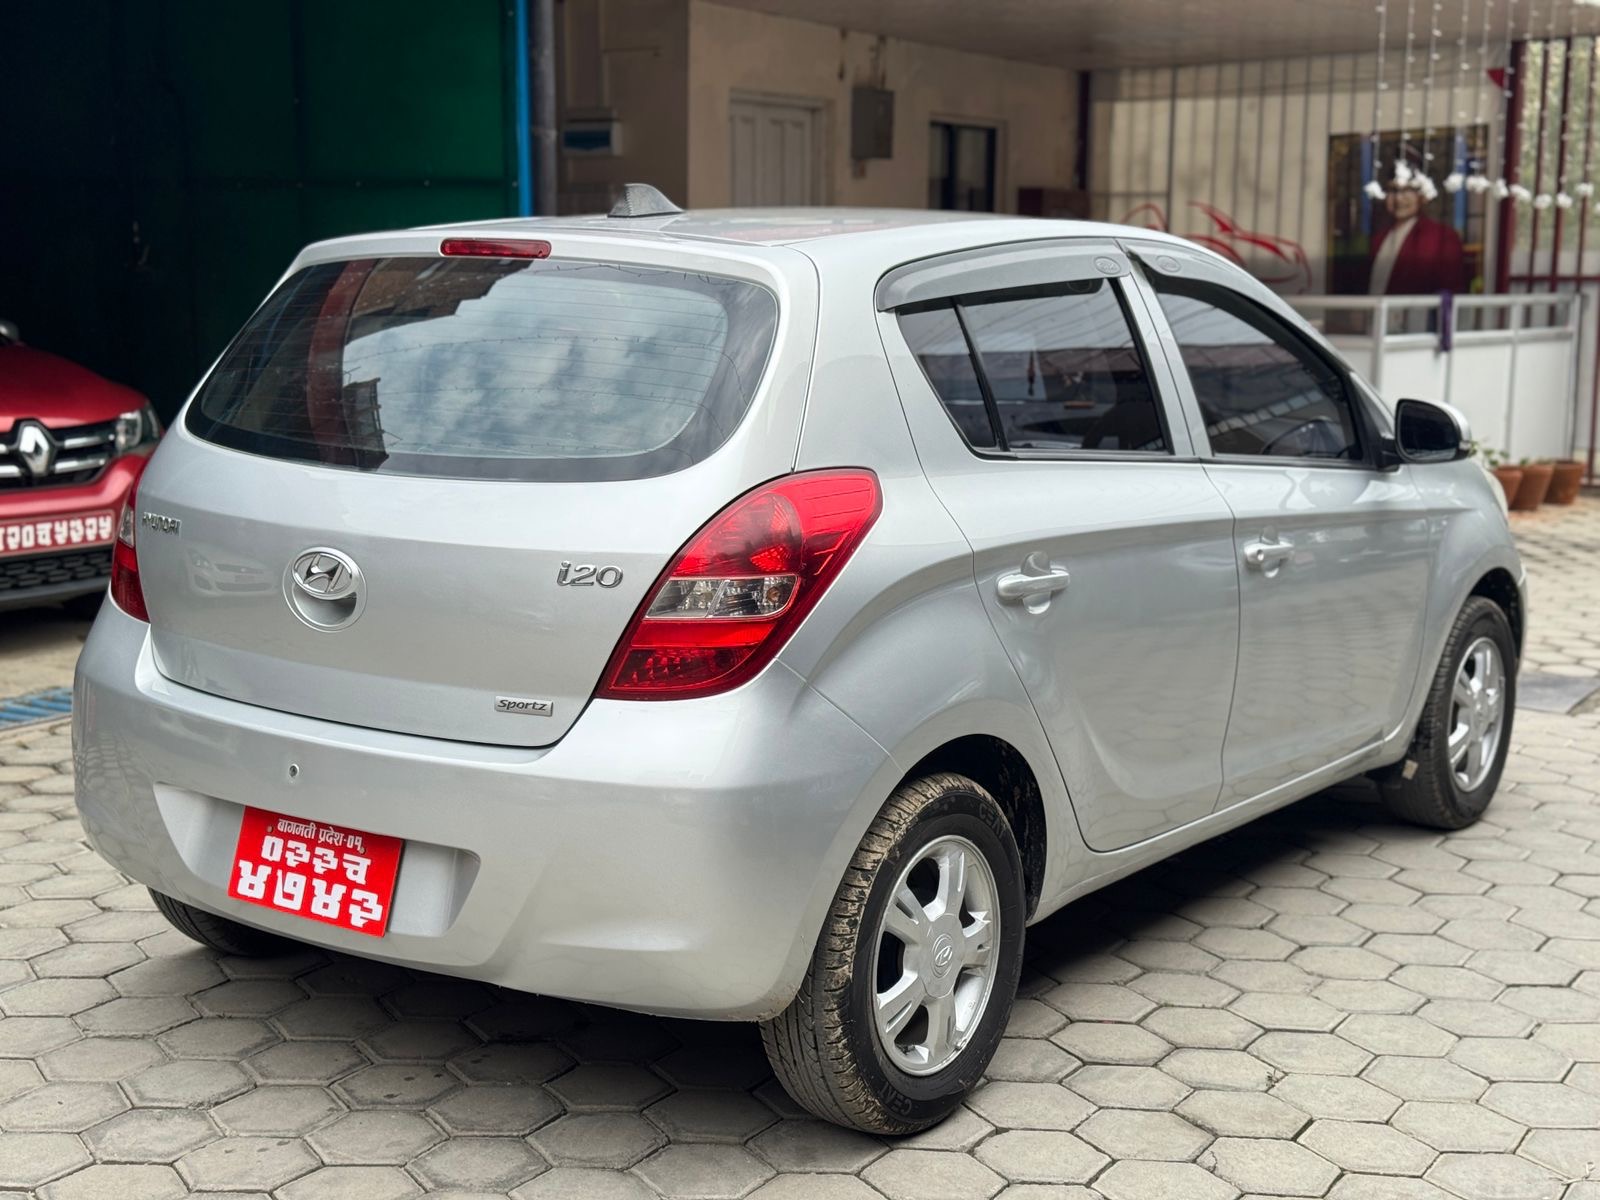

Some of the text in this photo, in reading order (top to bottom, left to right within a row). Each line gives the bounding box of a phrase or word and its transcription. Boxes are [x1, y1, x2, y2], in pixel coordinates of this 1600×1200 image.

[557, 560, 624, 589] i20
[497, 699, 548, 711] Sportz
[277, 818, 317, 840] बागमती
